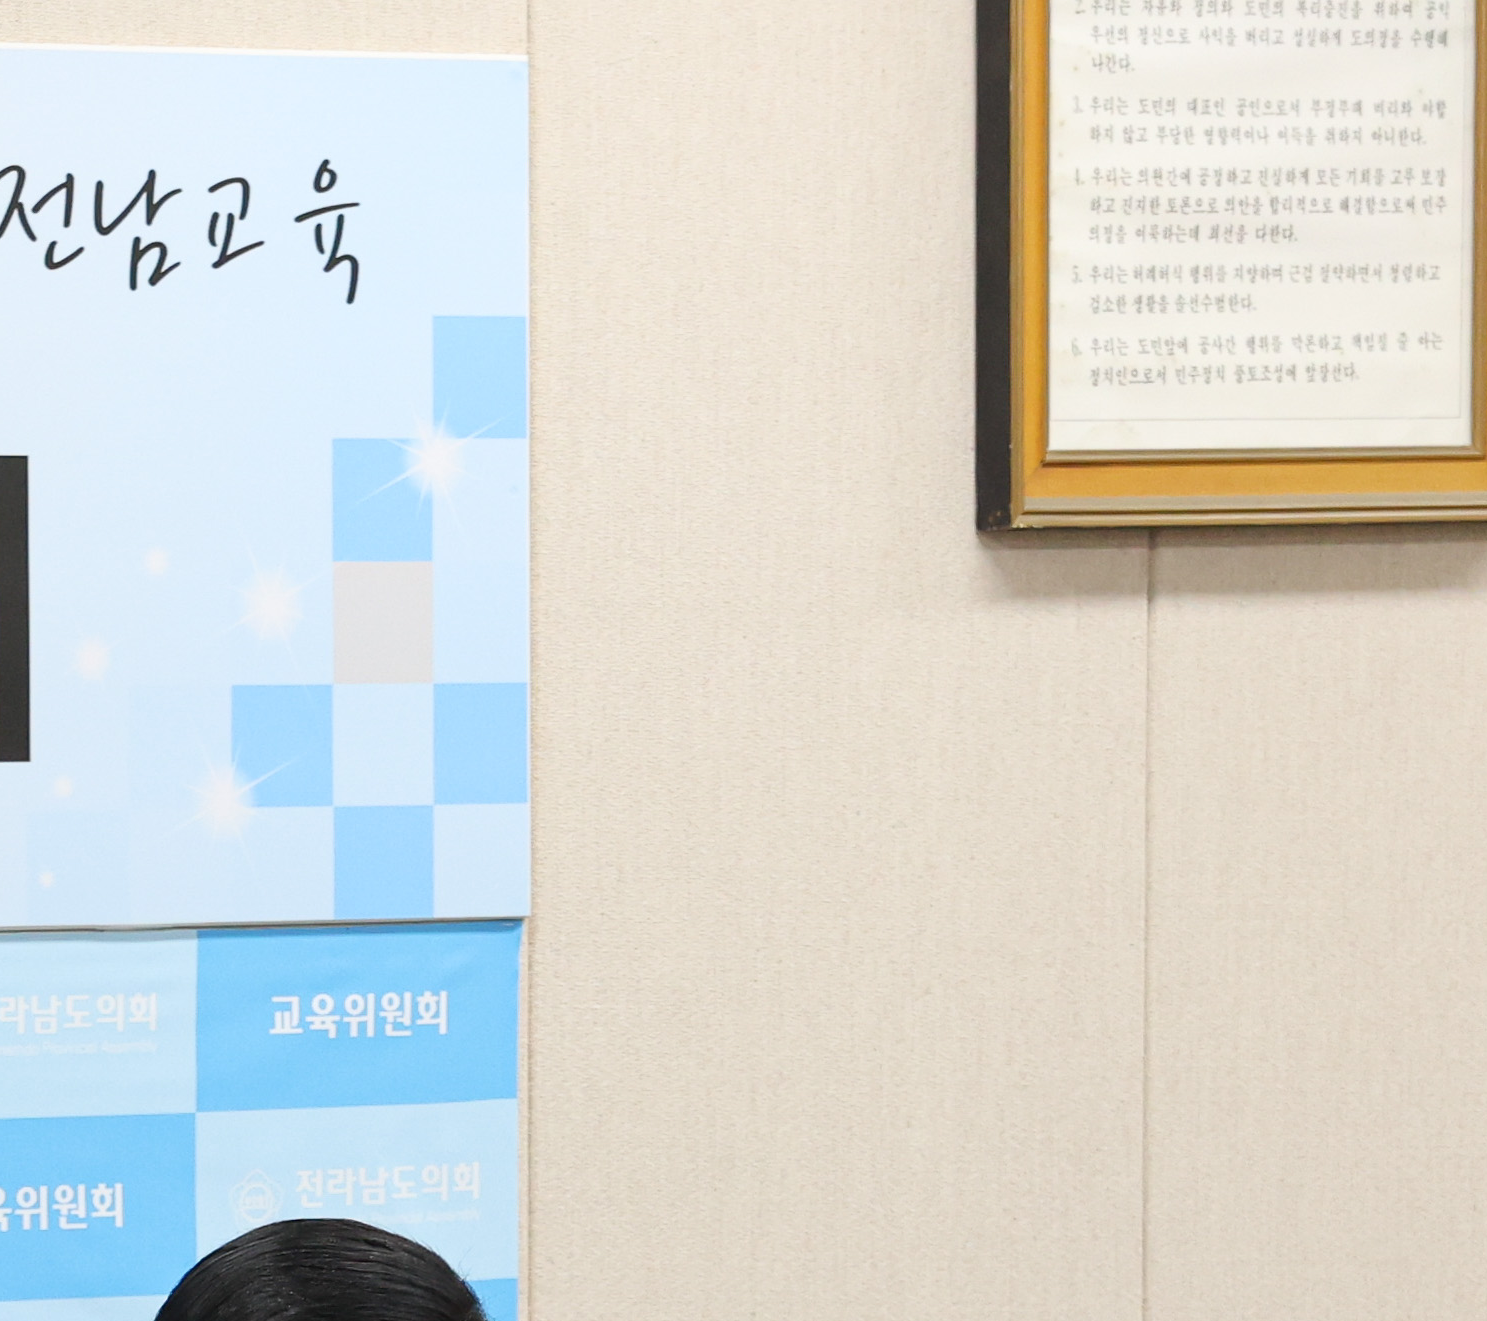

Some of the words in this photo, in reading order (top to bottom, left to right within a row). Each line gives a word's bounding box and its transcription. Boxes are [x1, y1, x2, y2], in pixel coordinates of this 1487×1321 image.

[1091, 53, 1135, 74] 나간다.
[1090, 96, 1129, 116] 우리는
[1138, 97, 1176, 117] 도민의
[1237, 97, 1300, 117] 공인으로서
[1092, 167, 1132, 187] 우리는
[1165, 196, 1220, 216] 토론으로
[1255, 223, 1298, 244] 다한다.
[1089, 265, 1128, 284] 우리는
[1090, 337, 1129, 357] 우리는
[271, 992, 448, 1039] 교육위원회
[299, 1164, 479, 1207] 전라남도의회
